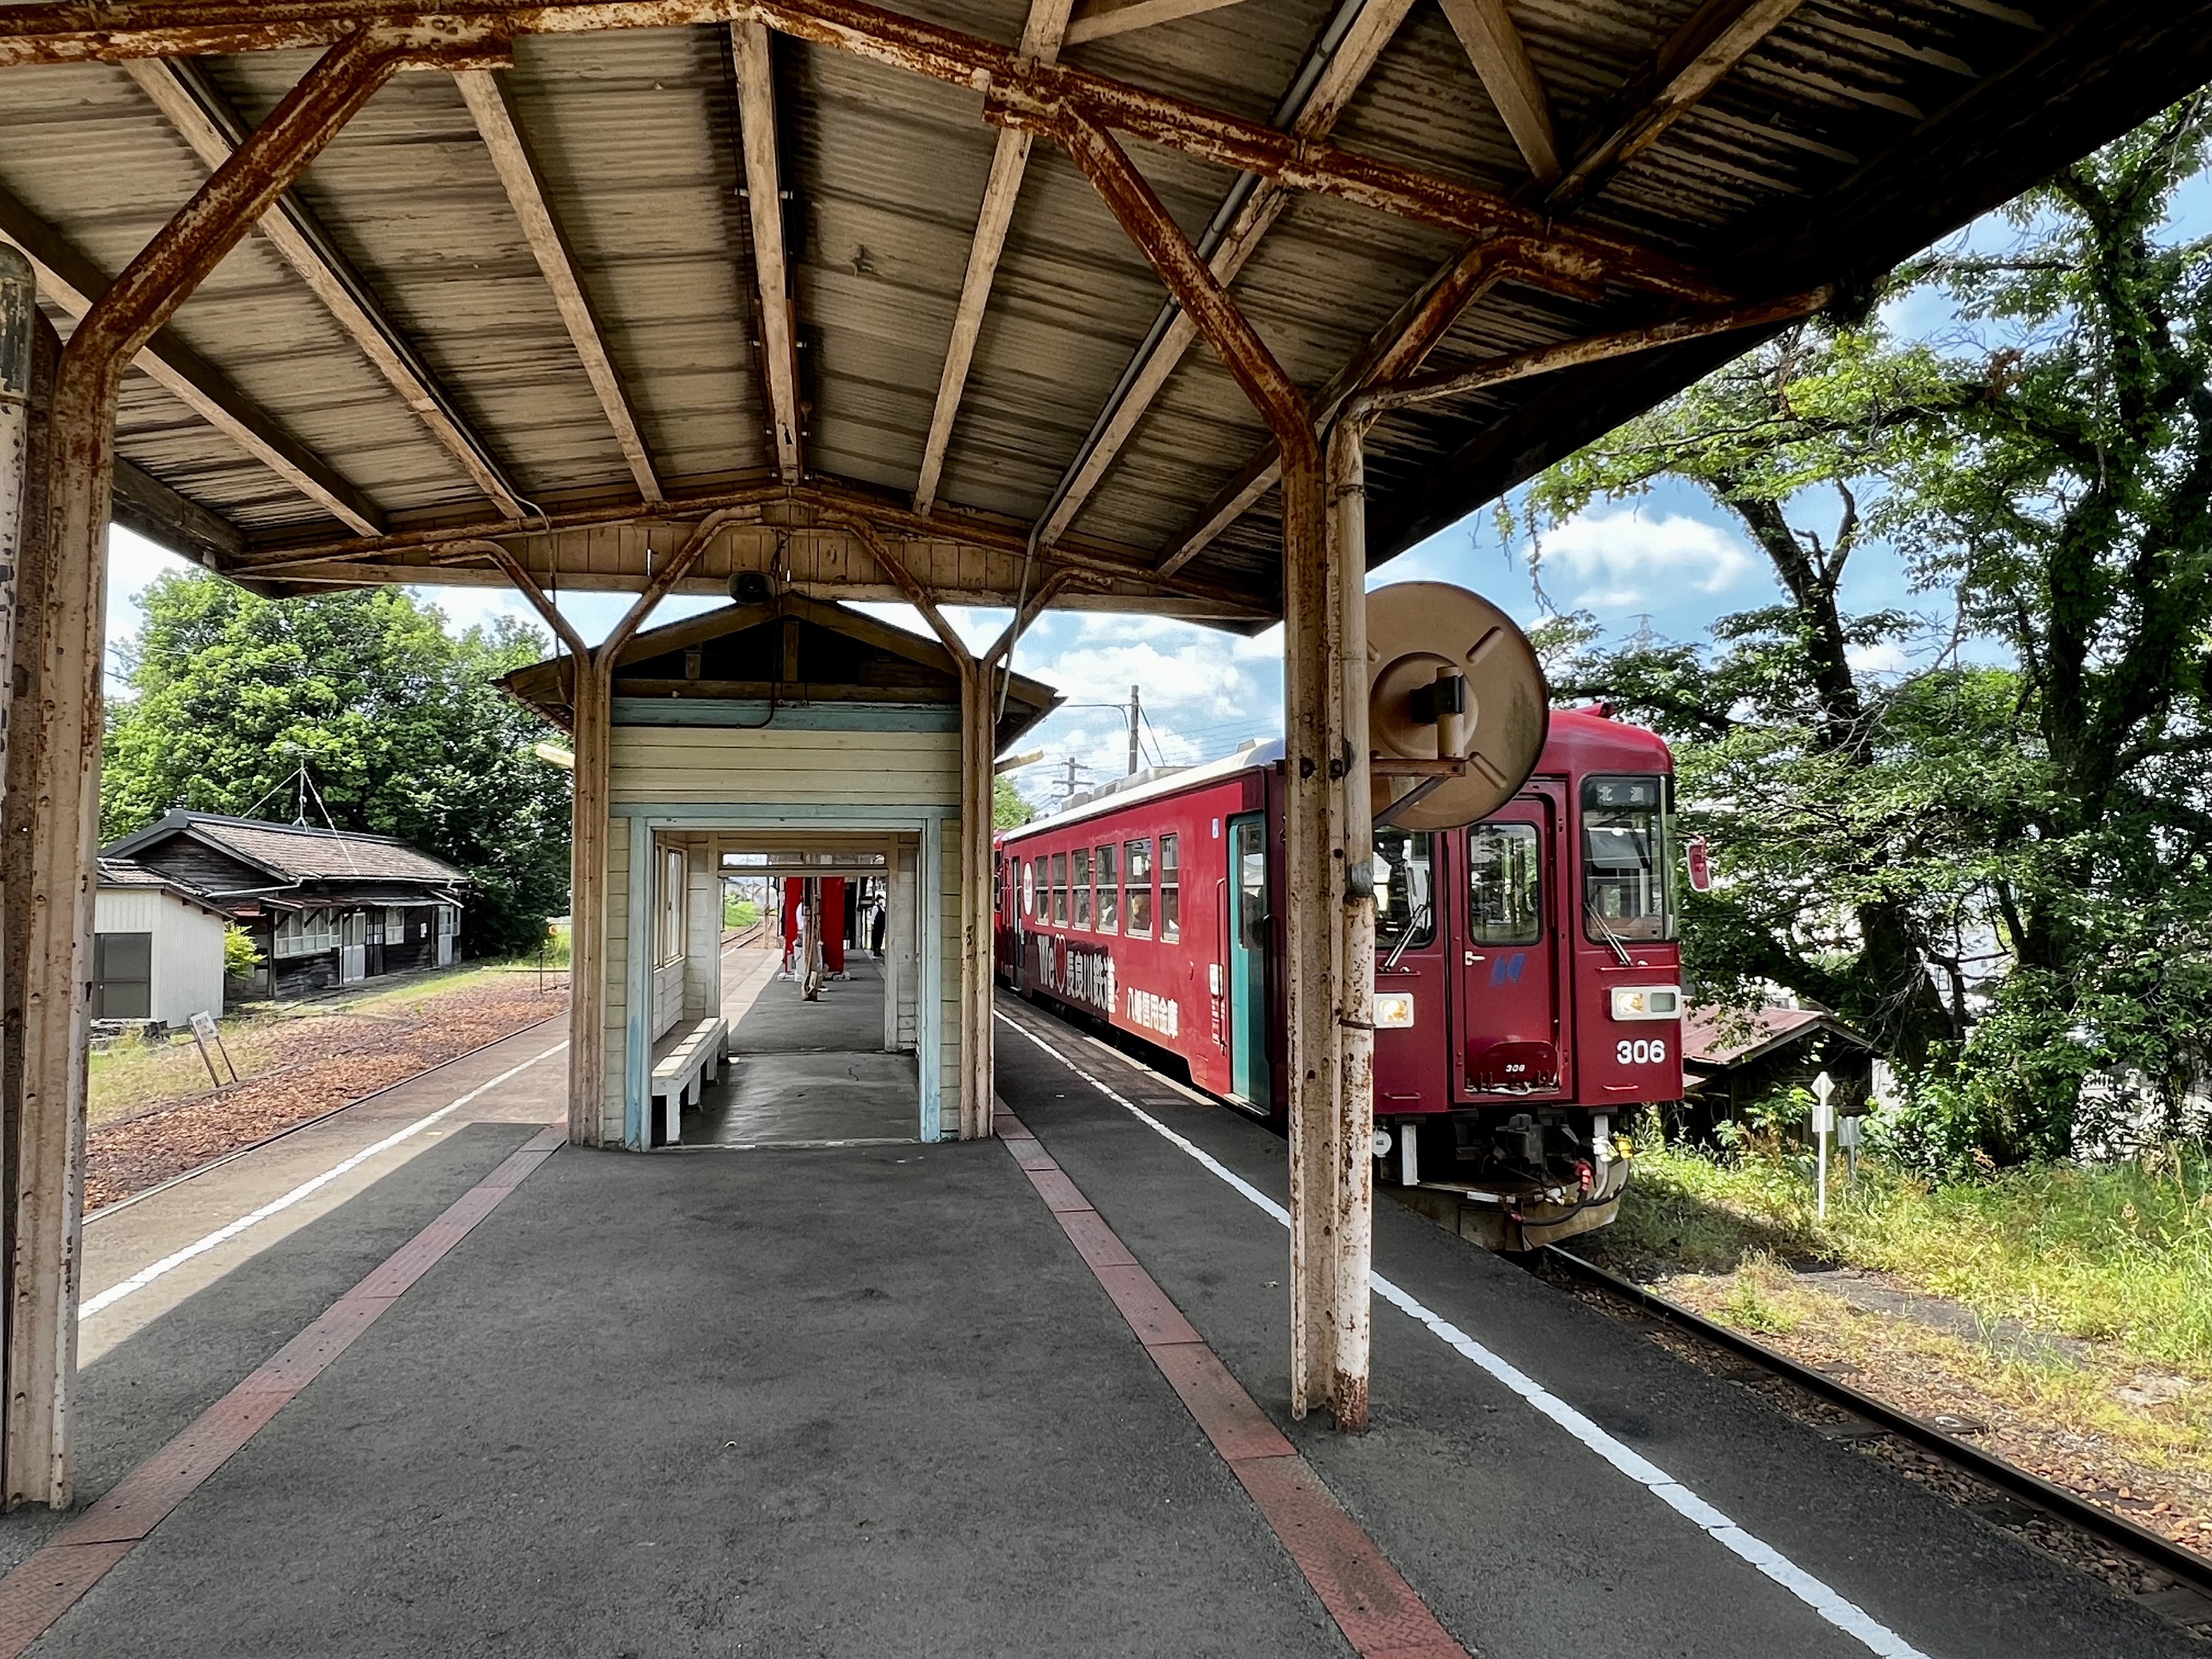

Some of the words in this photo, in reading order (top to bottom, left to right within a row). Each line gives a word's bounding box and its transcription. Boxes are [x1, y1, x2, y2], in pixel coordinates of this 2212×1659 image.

[1037, 934, 1055, 989] We
[1066, 949, 1116, 1014] 長良川鉄道
[1616, 1039, 1666, 1064] 306
